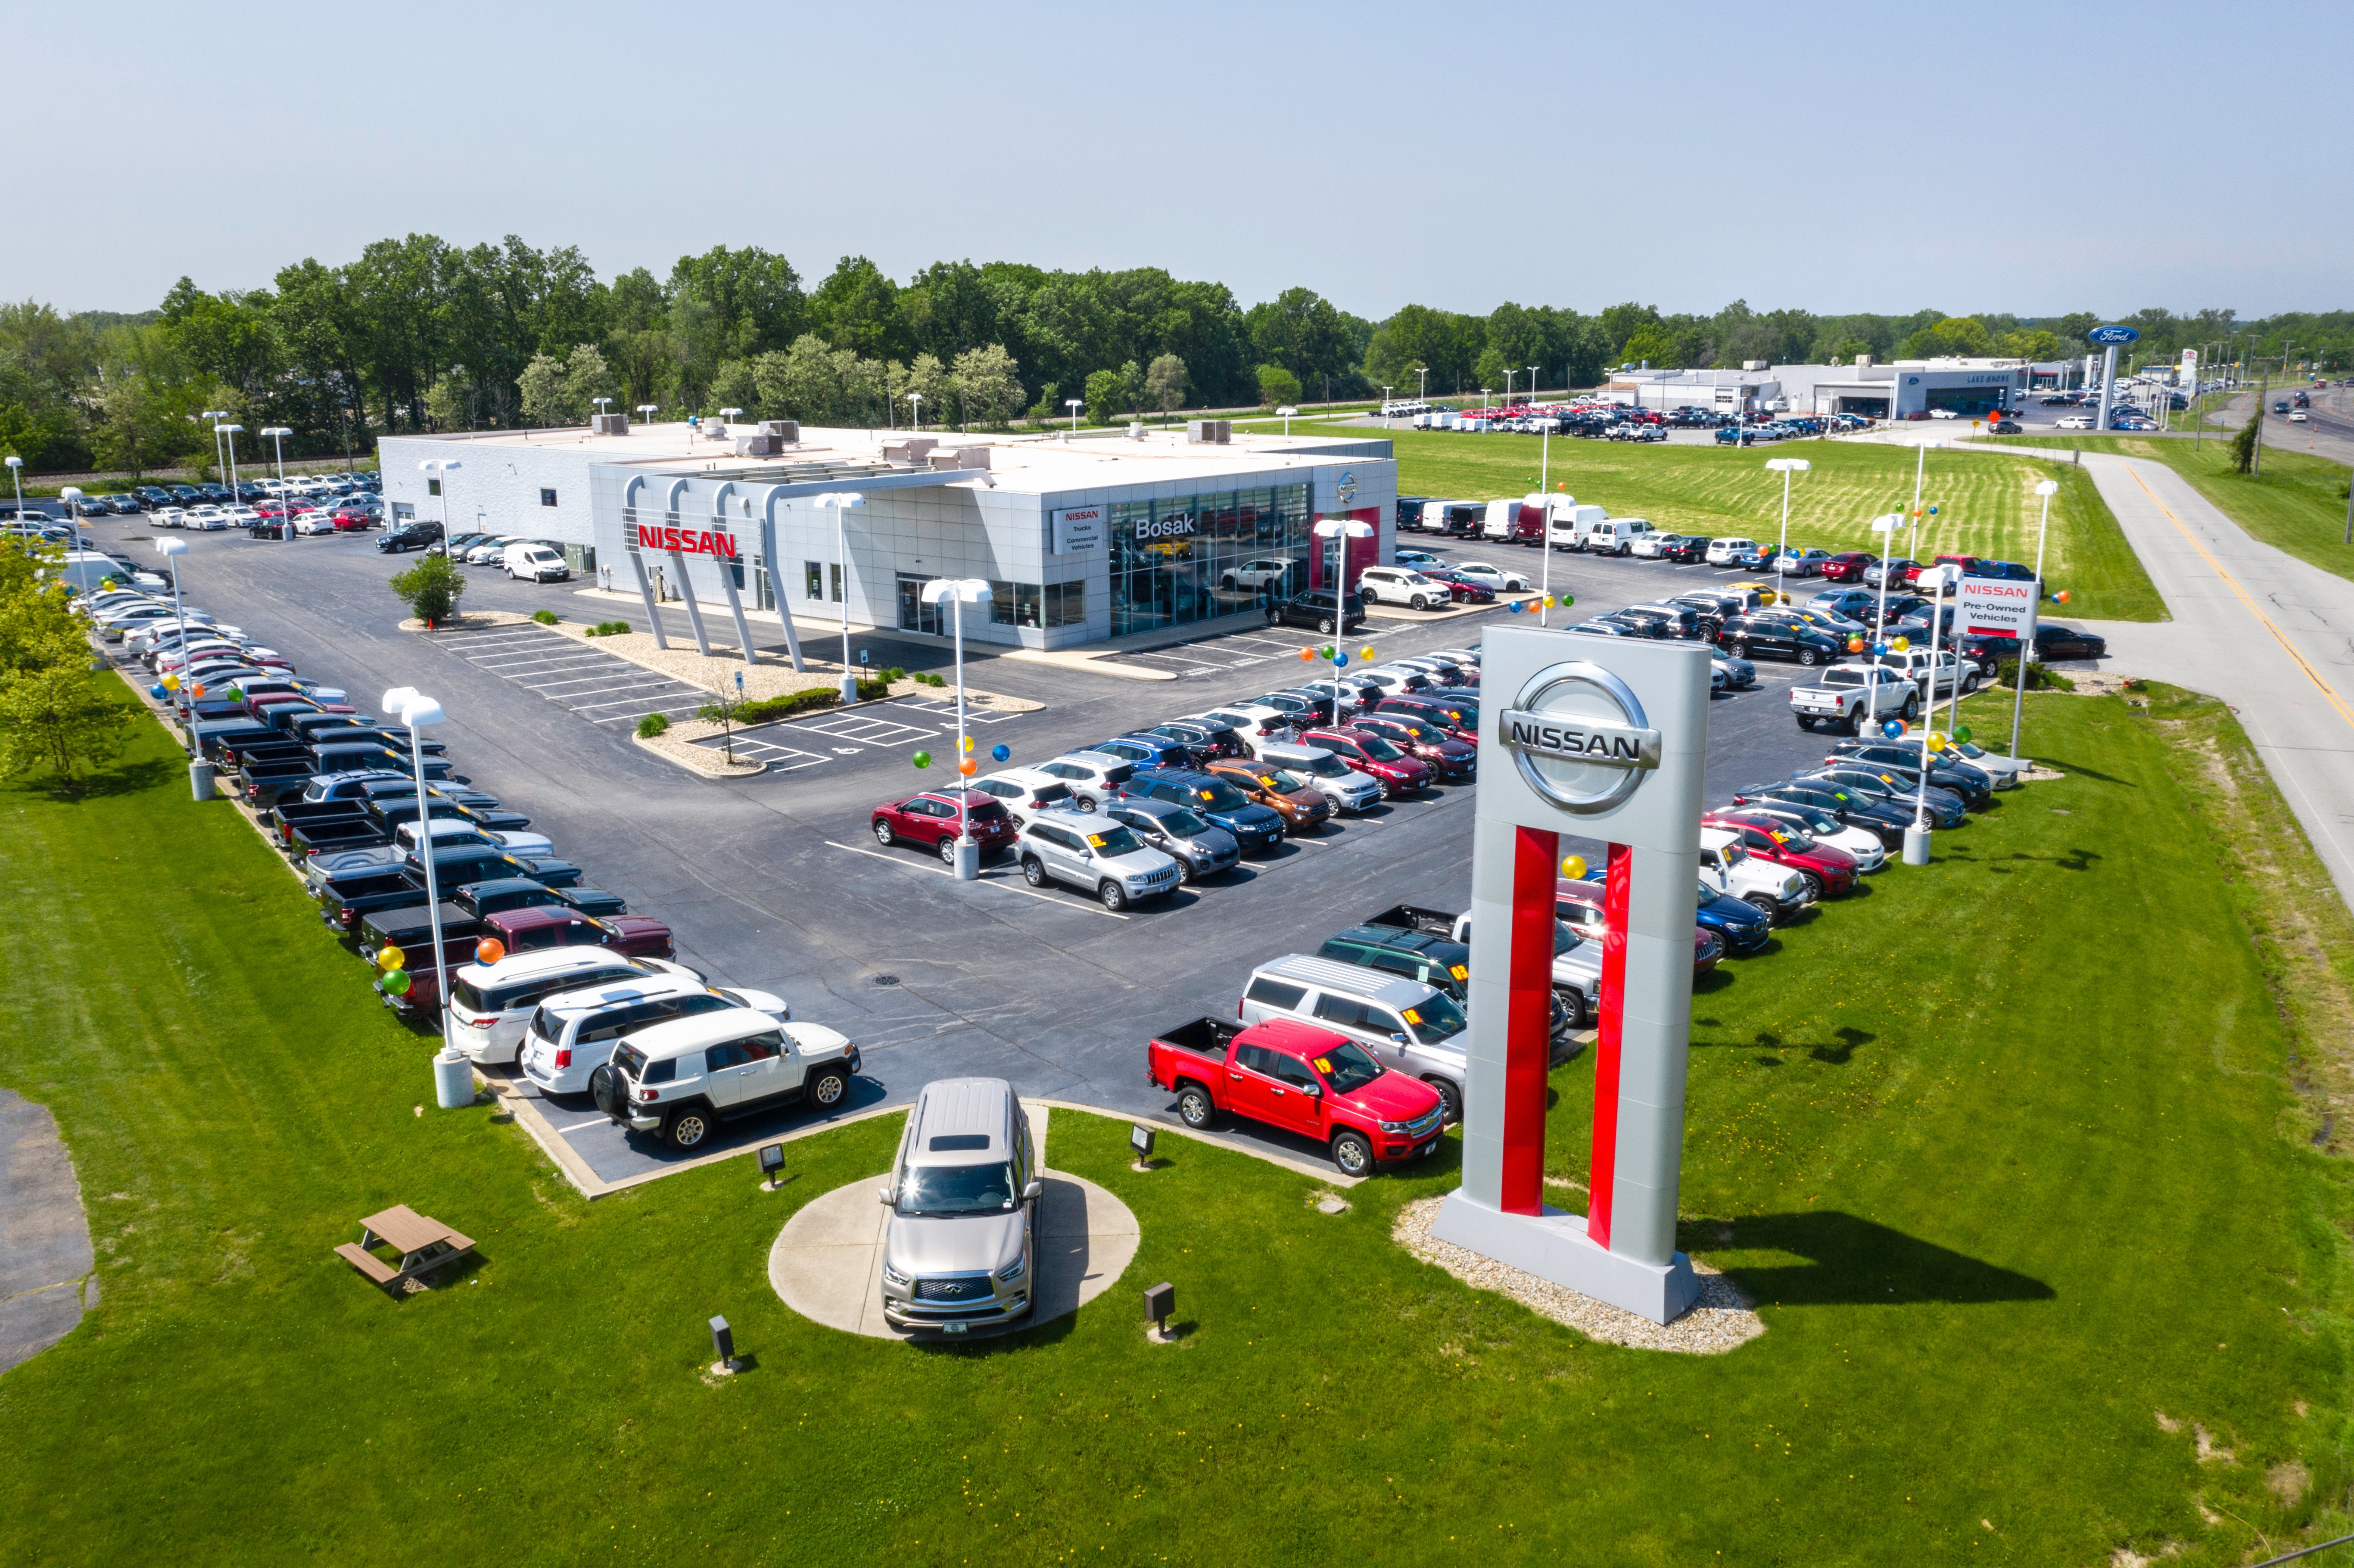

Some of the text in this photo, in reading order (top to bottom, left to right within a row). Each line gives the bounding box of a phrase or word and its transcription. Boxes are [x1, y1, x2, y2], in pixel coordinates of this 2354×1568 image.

[2099, 329, 2129, 341] Ford
[1066, 510, 1098, 521] NISSAN
[1136, 513, 1195, 539] Bosak
[638, 525, 736, 558] NISSAN
[1067, 535, 1098, 544] Commercial
[1965, 584, 2028, 598] NISSAN
[1964, 602, 2026, 613] Pre-Owned
[1970, 613, 2018, 622] Vehicles
[1511, 722, 1640, 761] NISSAN
[1200, 791, 1212, 800] 16
[1087, 834, 1101, 844] 12
[1451, 965, 1468, 980] 03
[1402, 1009, 1420, 1024] 18
[1314, 1058, 1330, 1073] 19
